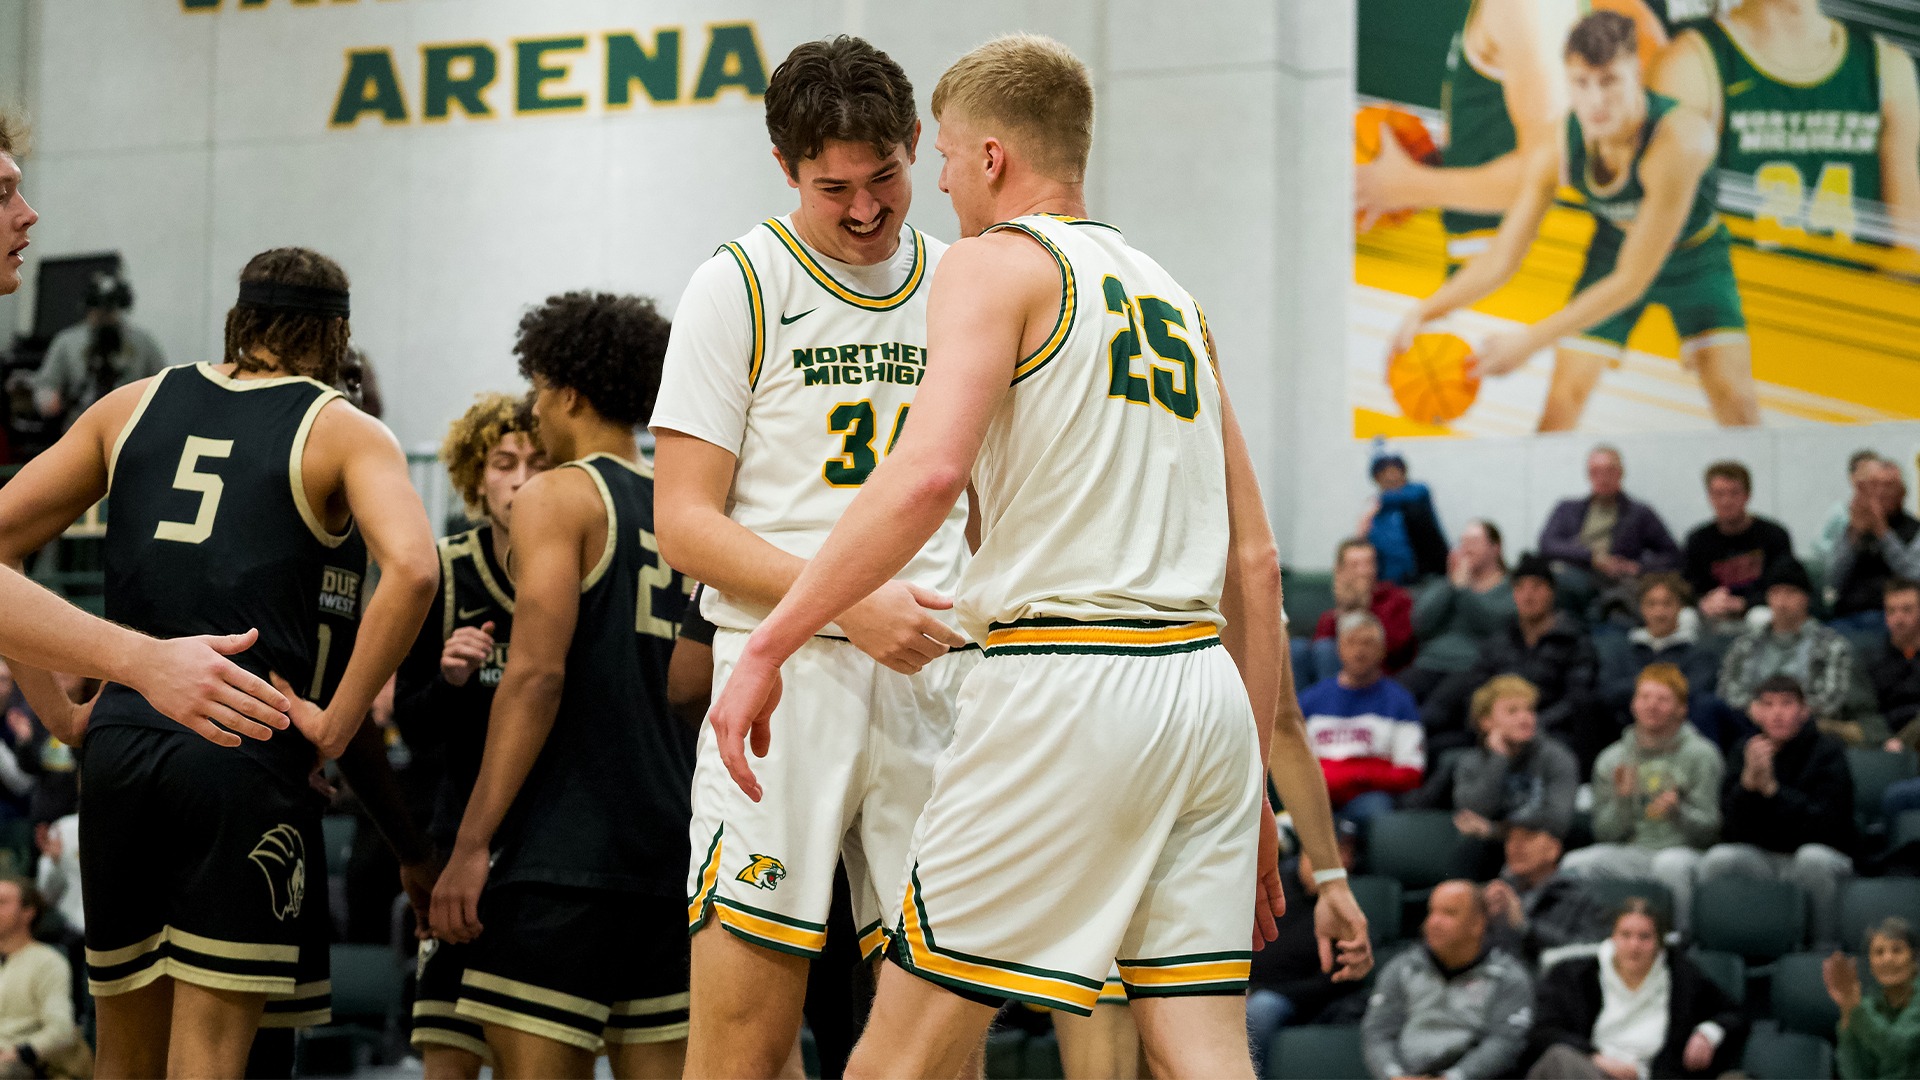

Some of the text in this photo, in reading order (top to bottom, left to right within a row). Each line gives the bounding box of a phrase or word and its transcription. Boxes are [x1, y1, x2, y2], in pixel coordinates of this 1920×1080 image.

[328, 20, 769, 130] ARENA
[792, 341, 928, 369] NORTHE
[1101, 273, 1200, 423] 25
[153, 435, 235, 545] 5
[635, 528, 699, 640] 2
